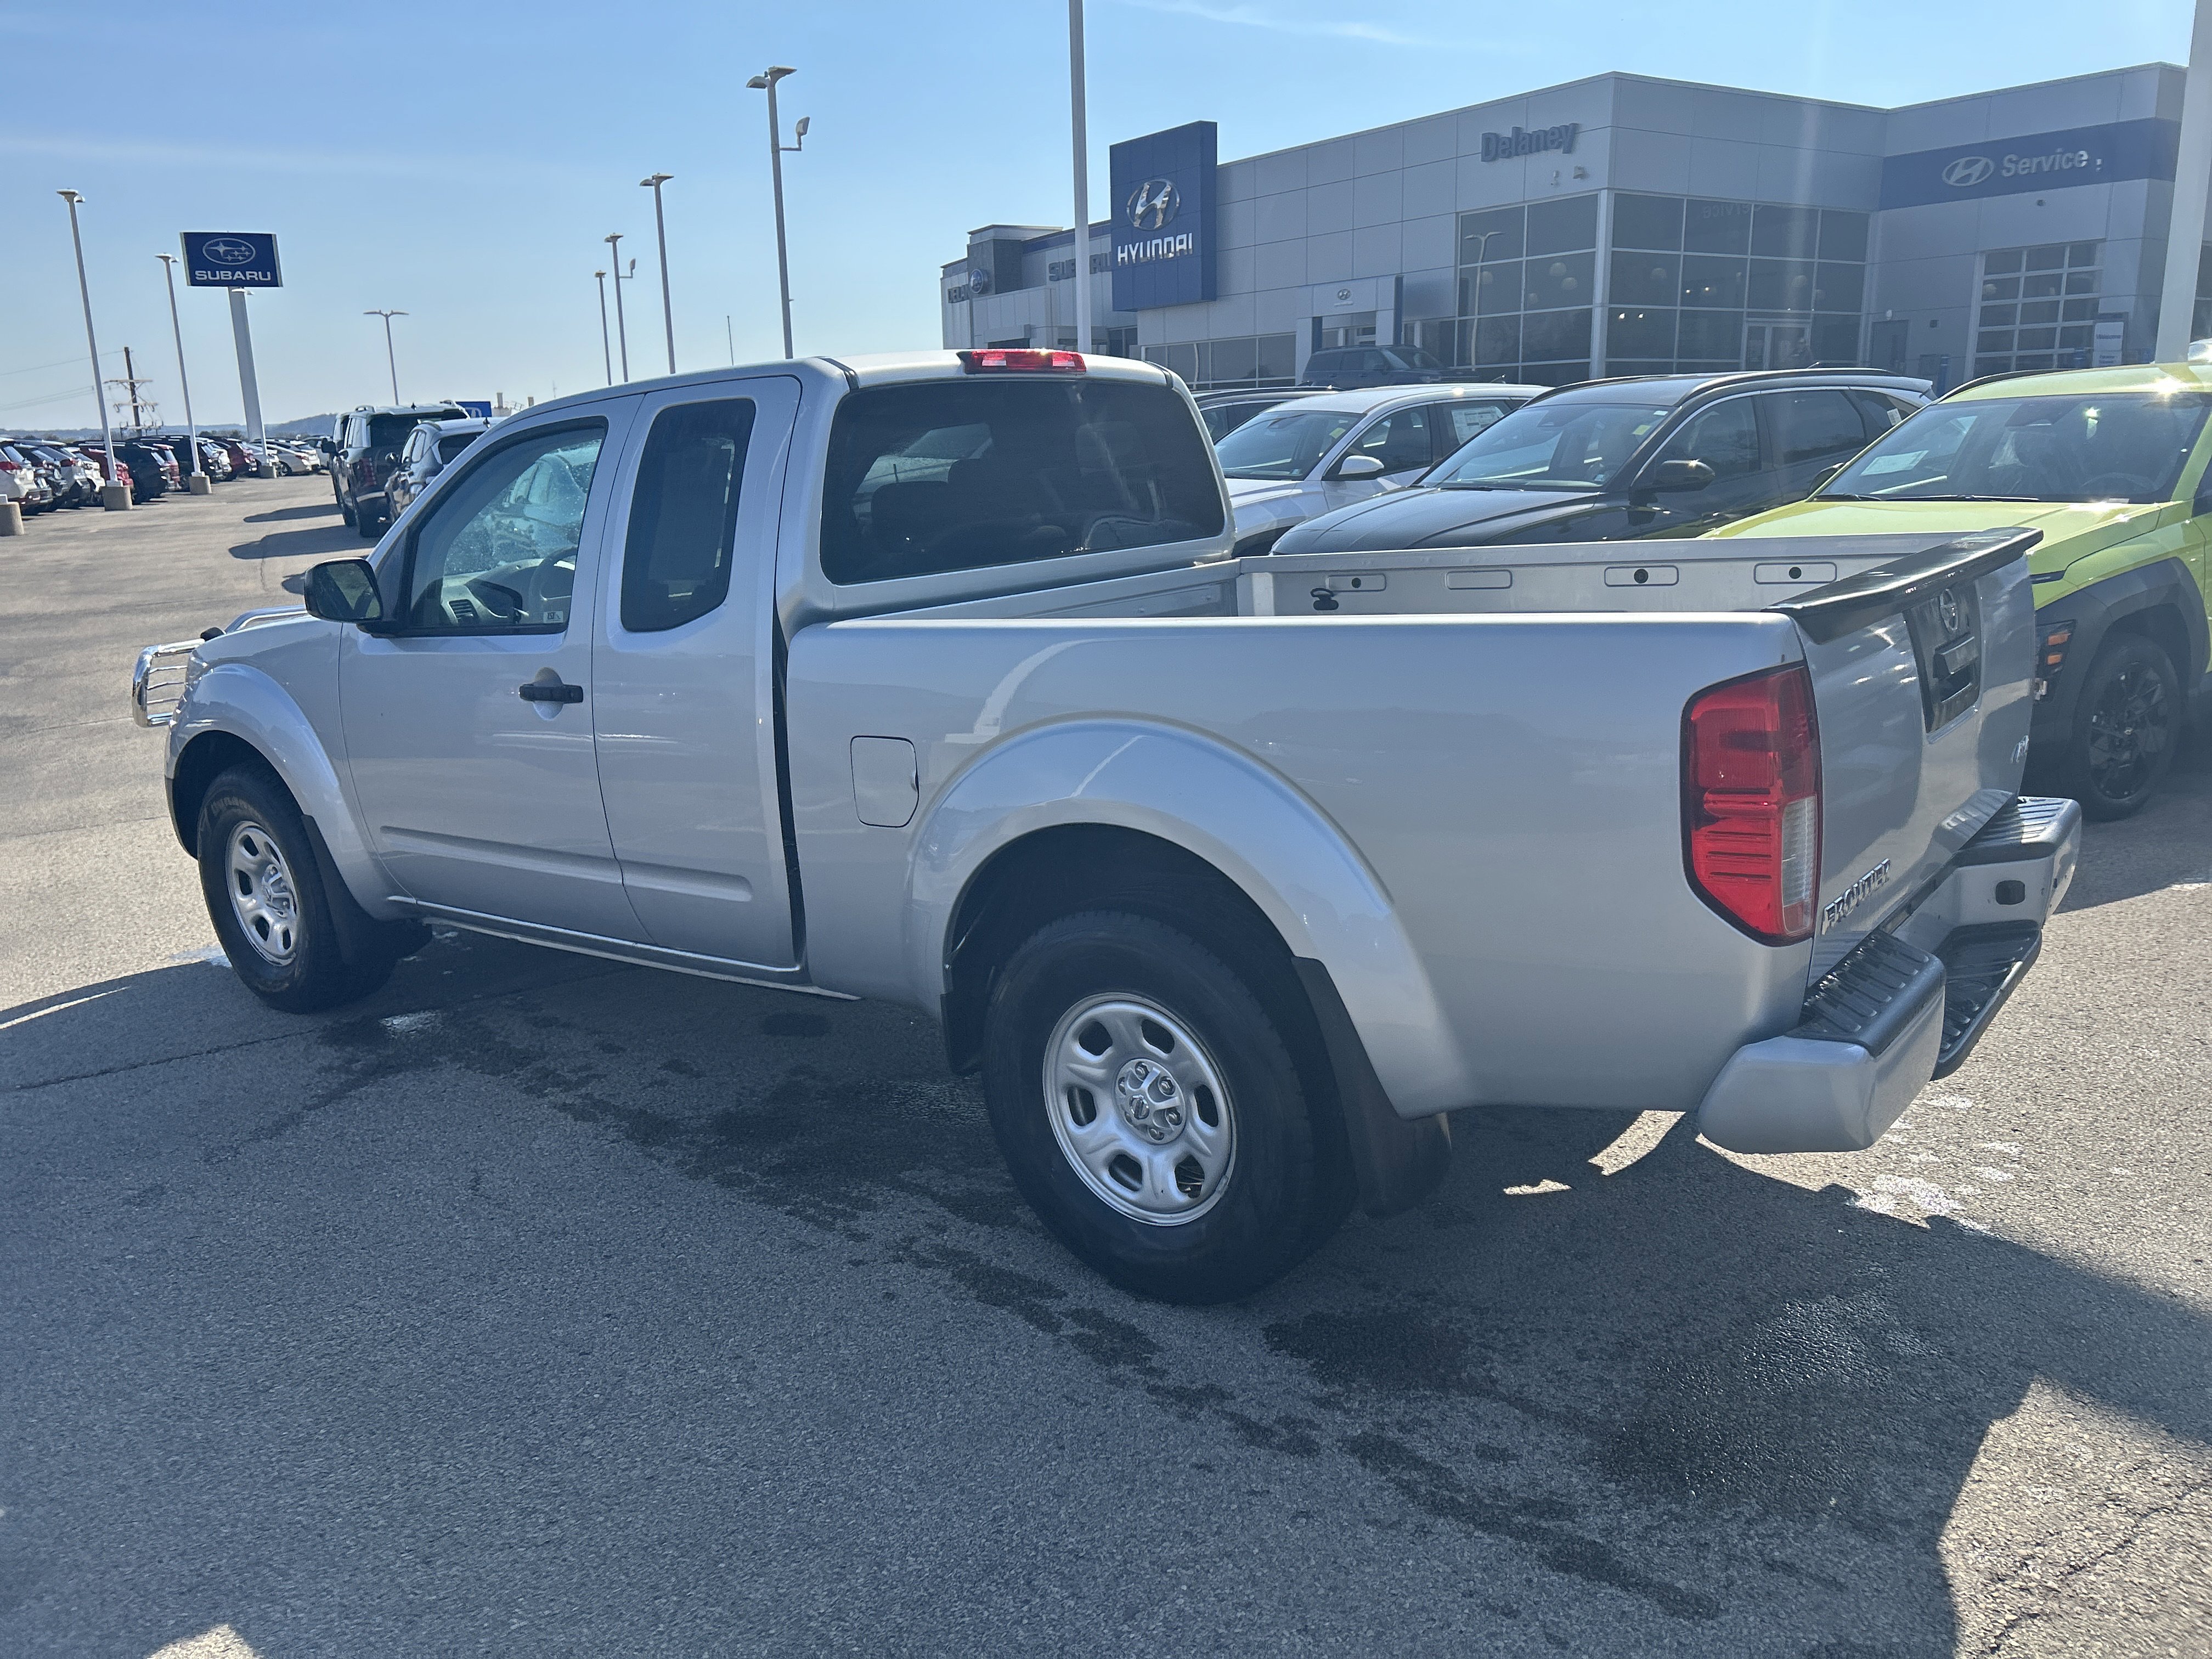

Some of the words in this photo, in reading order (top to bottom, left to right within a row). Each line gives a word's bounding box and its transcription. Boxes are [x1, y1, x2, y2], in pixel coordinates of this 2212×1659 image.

[1481, 123, 1578, 162] Delaney
[2002, 148, 2089, 177] Service
[1048, 251, 1111, 281] SUBRU
[1118, 233, 1193, 267] HYUNDAI
[195, 270, 271, 281] SUBARU
[1821, 859, 1891, 935] FRONTIER
